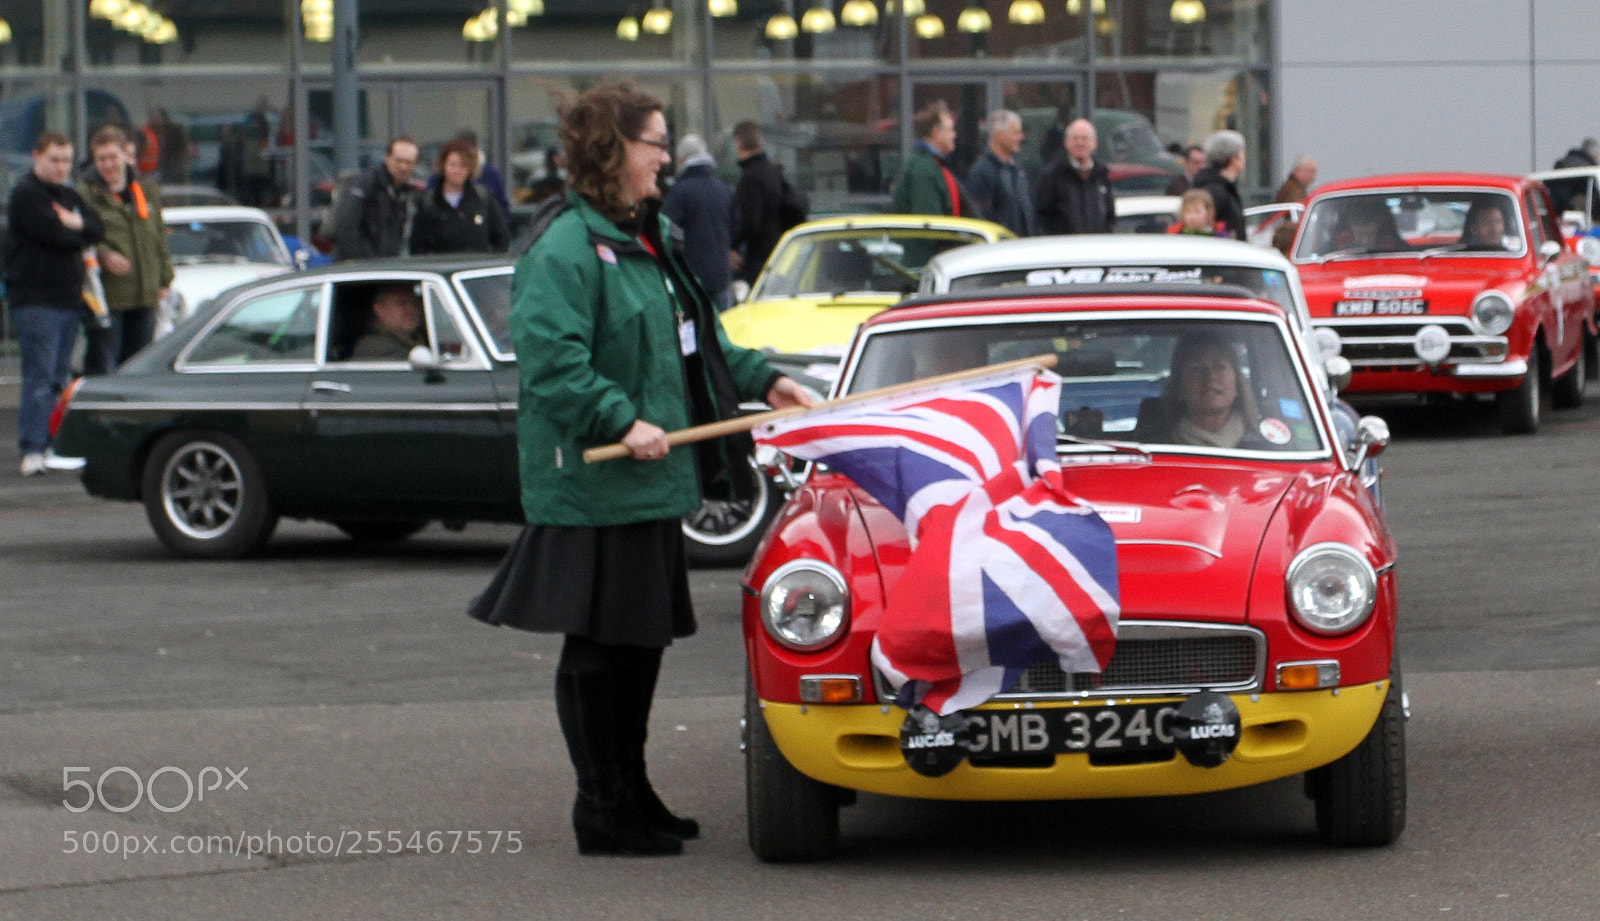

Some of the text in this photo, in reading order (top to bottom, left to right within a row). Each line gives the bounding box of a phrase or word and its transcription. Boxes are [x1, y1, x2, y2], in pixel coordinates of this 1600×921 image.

[909, 731, 955, 748] LUCAS
[966, 713, 1050, 753] GMB
[1190, 724, 1235, 739] LUCAS
